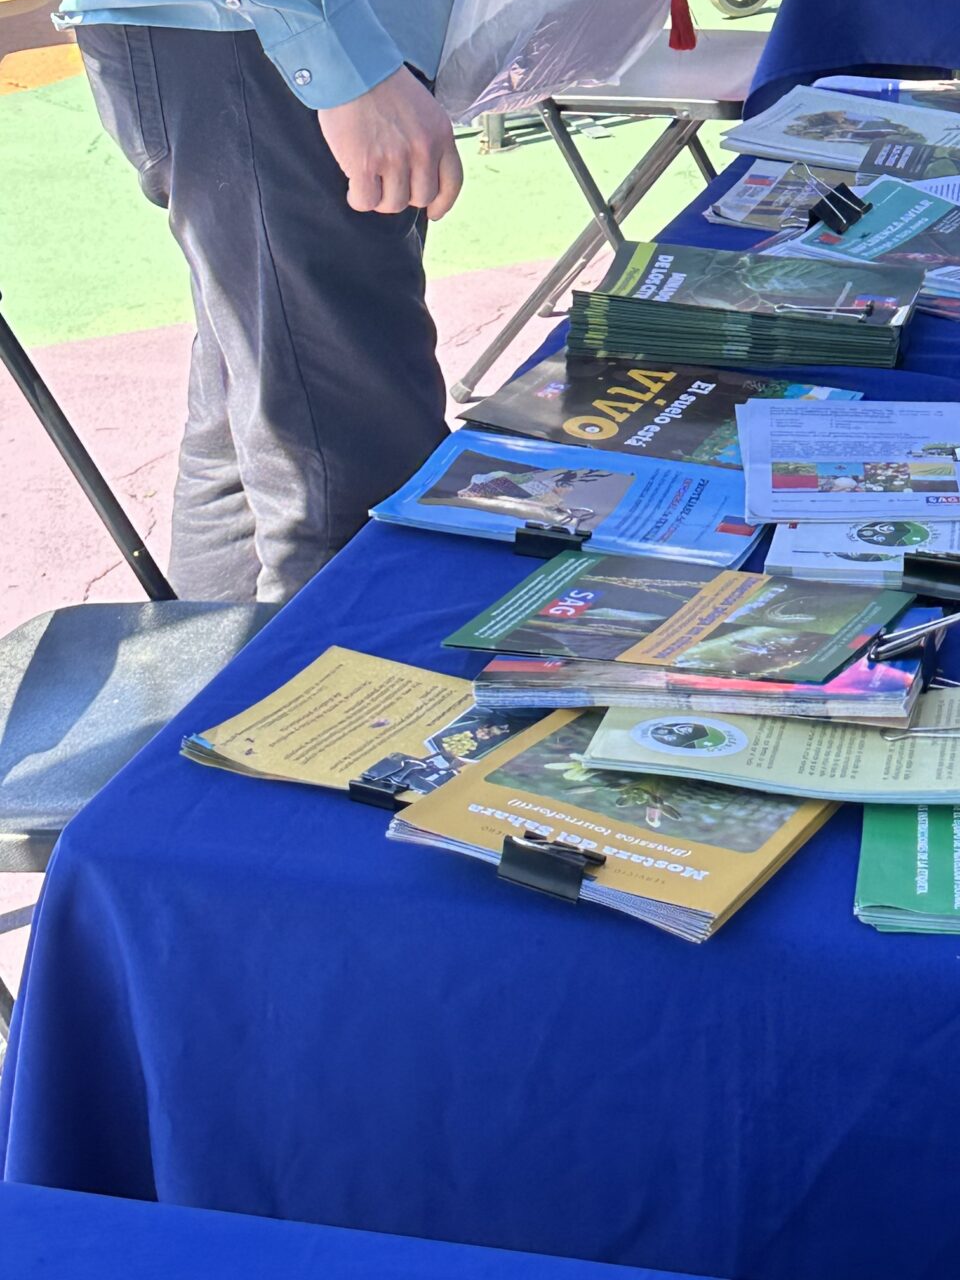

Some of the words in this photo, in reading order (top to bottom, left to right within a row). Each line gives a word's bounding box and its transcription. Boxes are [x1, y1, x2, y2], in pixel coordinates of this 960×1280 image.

[654, 255, 674, 268] DE
[645, 268, 668, 285] LOS
[687, 380, 716, 395] El
[654, 393, 696, 424] suelo
[624, 424, 661, 447] está
[926, 496, 960, 504] SAG
[550, 589, 594, 616] SAG
[467, 803, 554, 837] Sahara
[558, 830, 598, 851] del
[602, 845, 710, 881] Mostaza
